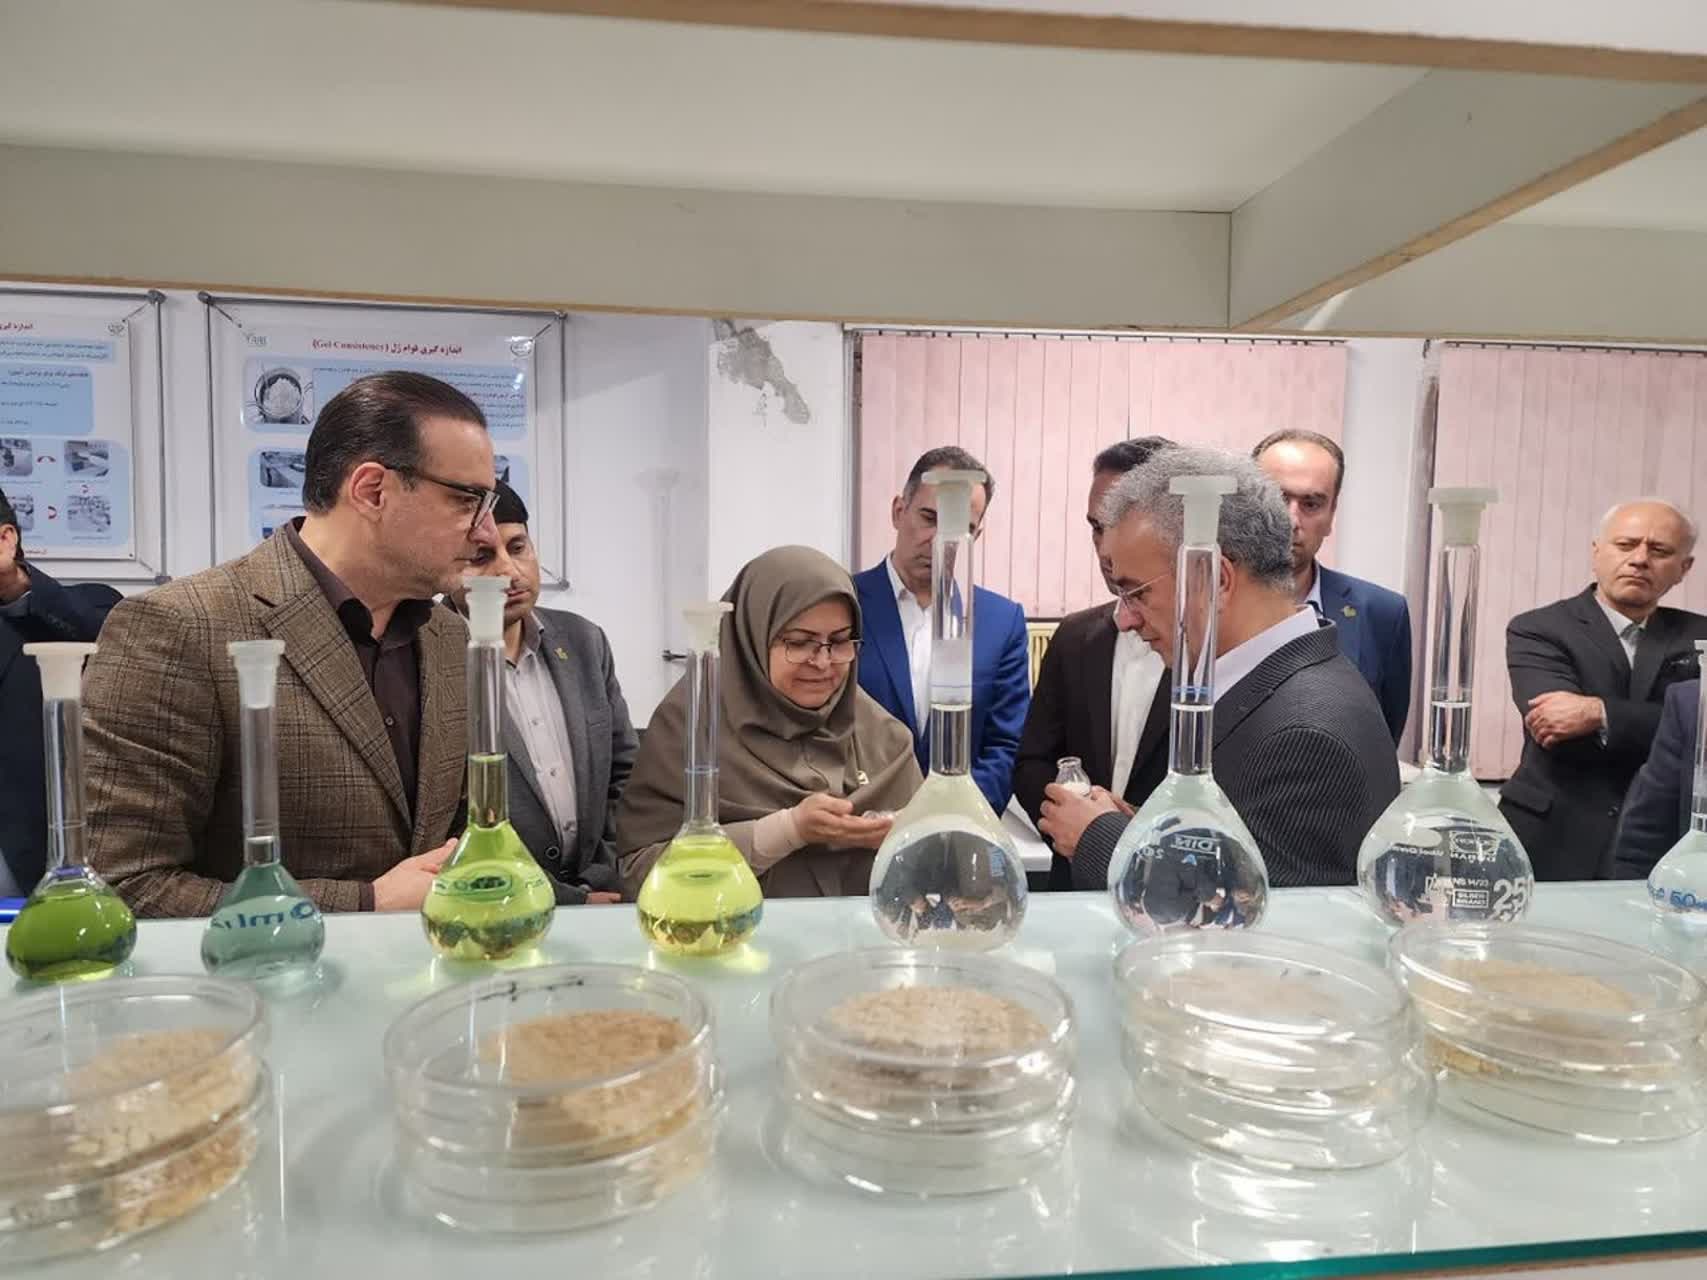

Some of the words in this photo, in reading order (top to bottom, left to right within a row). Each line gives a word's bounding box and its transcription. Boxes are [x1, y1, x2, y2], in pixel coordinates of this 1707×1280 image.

[390, 342, 402, 354] ژل
[403, 343, 419, 354] قوام
[420, 344, 438, 355] گیری
[440, 344, 462, 356] اندازه
